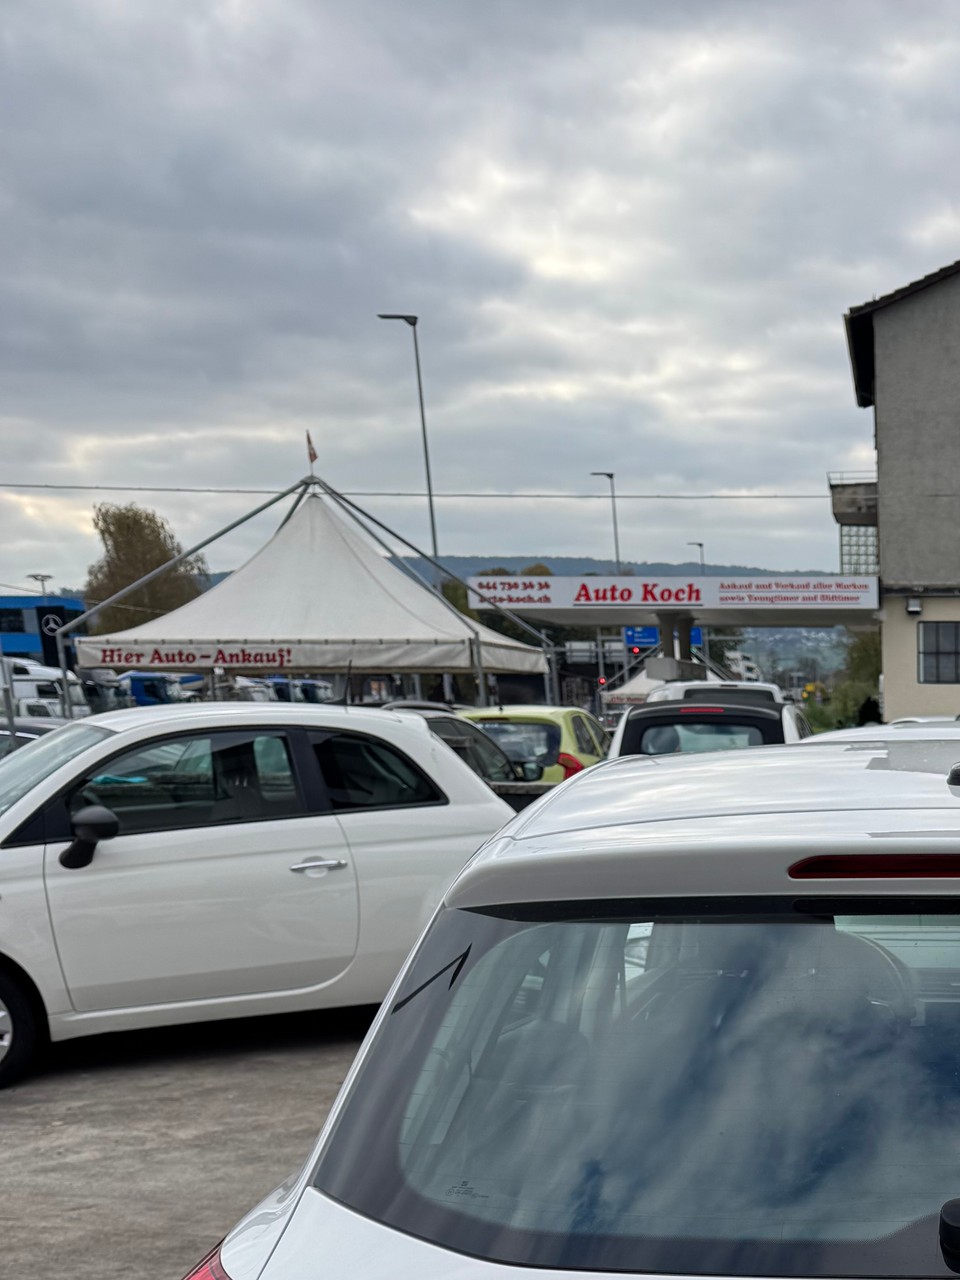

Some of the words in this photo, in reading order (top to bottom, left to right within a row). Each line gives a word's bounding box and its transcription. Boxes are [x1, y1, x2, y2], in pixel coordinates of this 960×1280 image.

[574, 583, 633, 602] Auto
[640, 583, 702, 602] Koch
[101, 648, 145, 664] Hier
